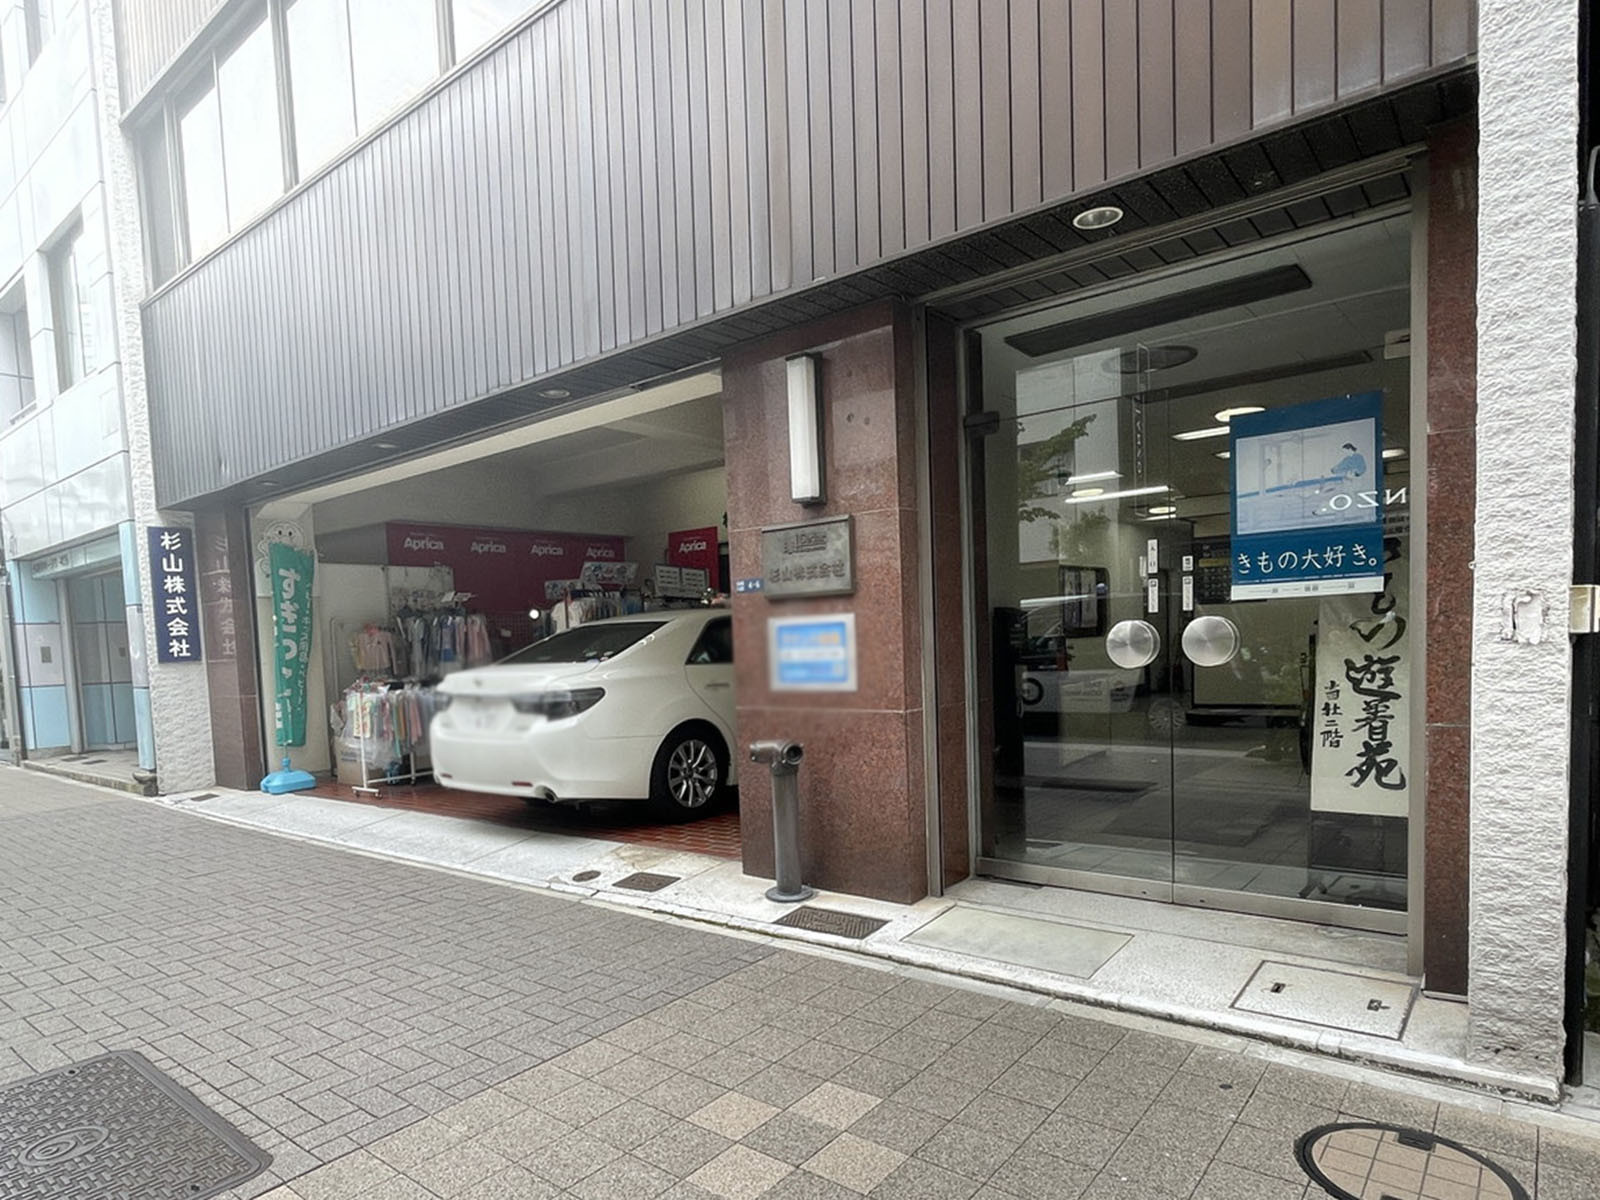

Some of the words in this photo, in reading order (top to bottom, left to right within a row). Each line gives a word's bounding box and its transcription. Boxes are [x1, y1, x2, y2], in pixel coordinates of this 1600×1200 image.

[404, 537, 445, 551] Aprica
[470, 541, 507, 554] Aprica
[530, 544, 564, 556] Aprica
[678, 540, 707, 553] Aprica
[586, 546, 615, 558] Aprica
[1237, 543, 1377, 574] きもの大好き。
[160, 531, 192, 657] 杉山株式会社
[1320, 680, 1344, 748] 当社二階
